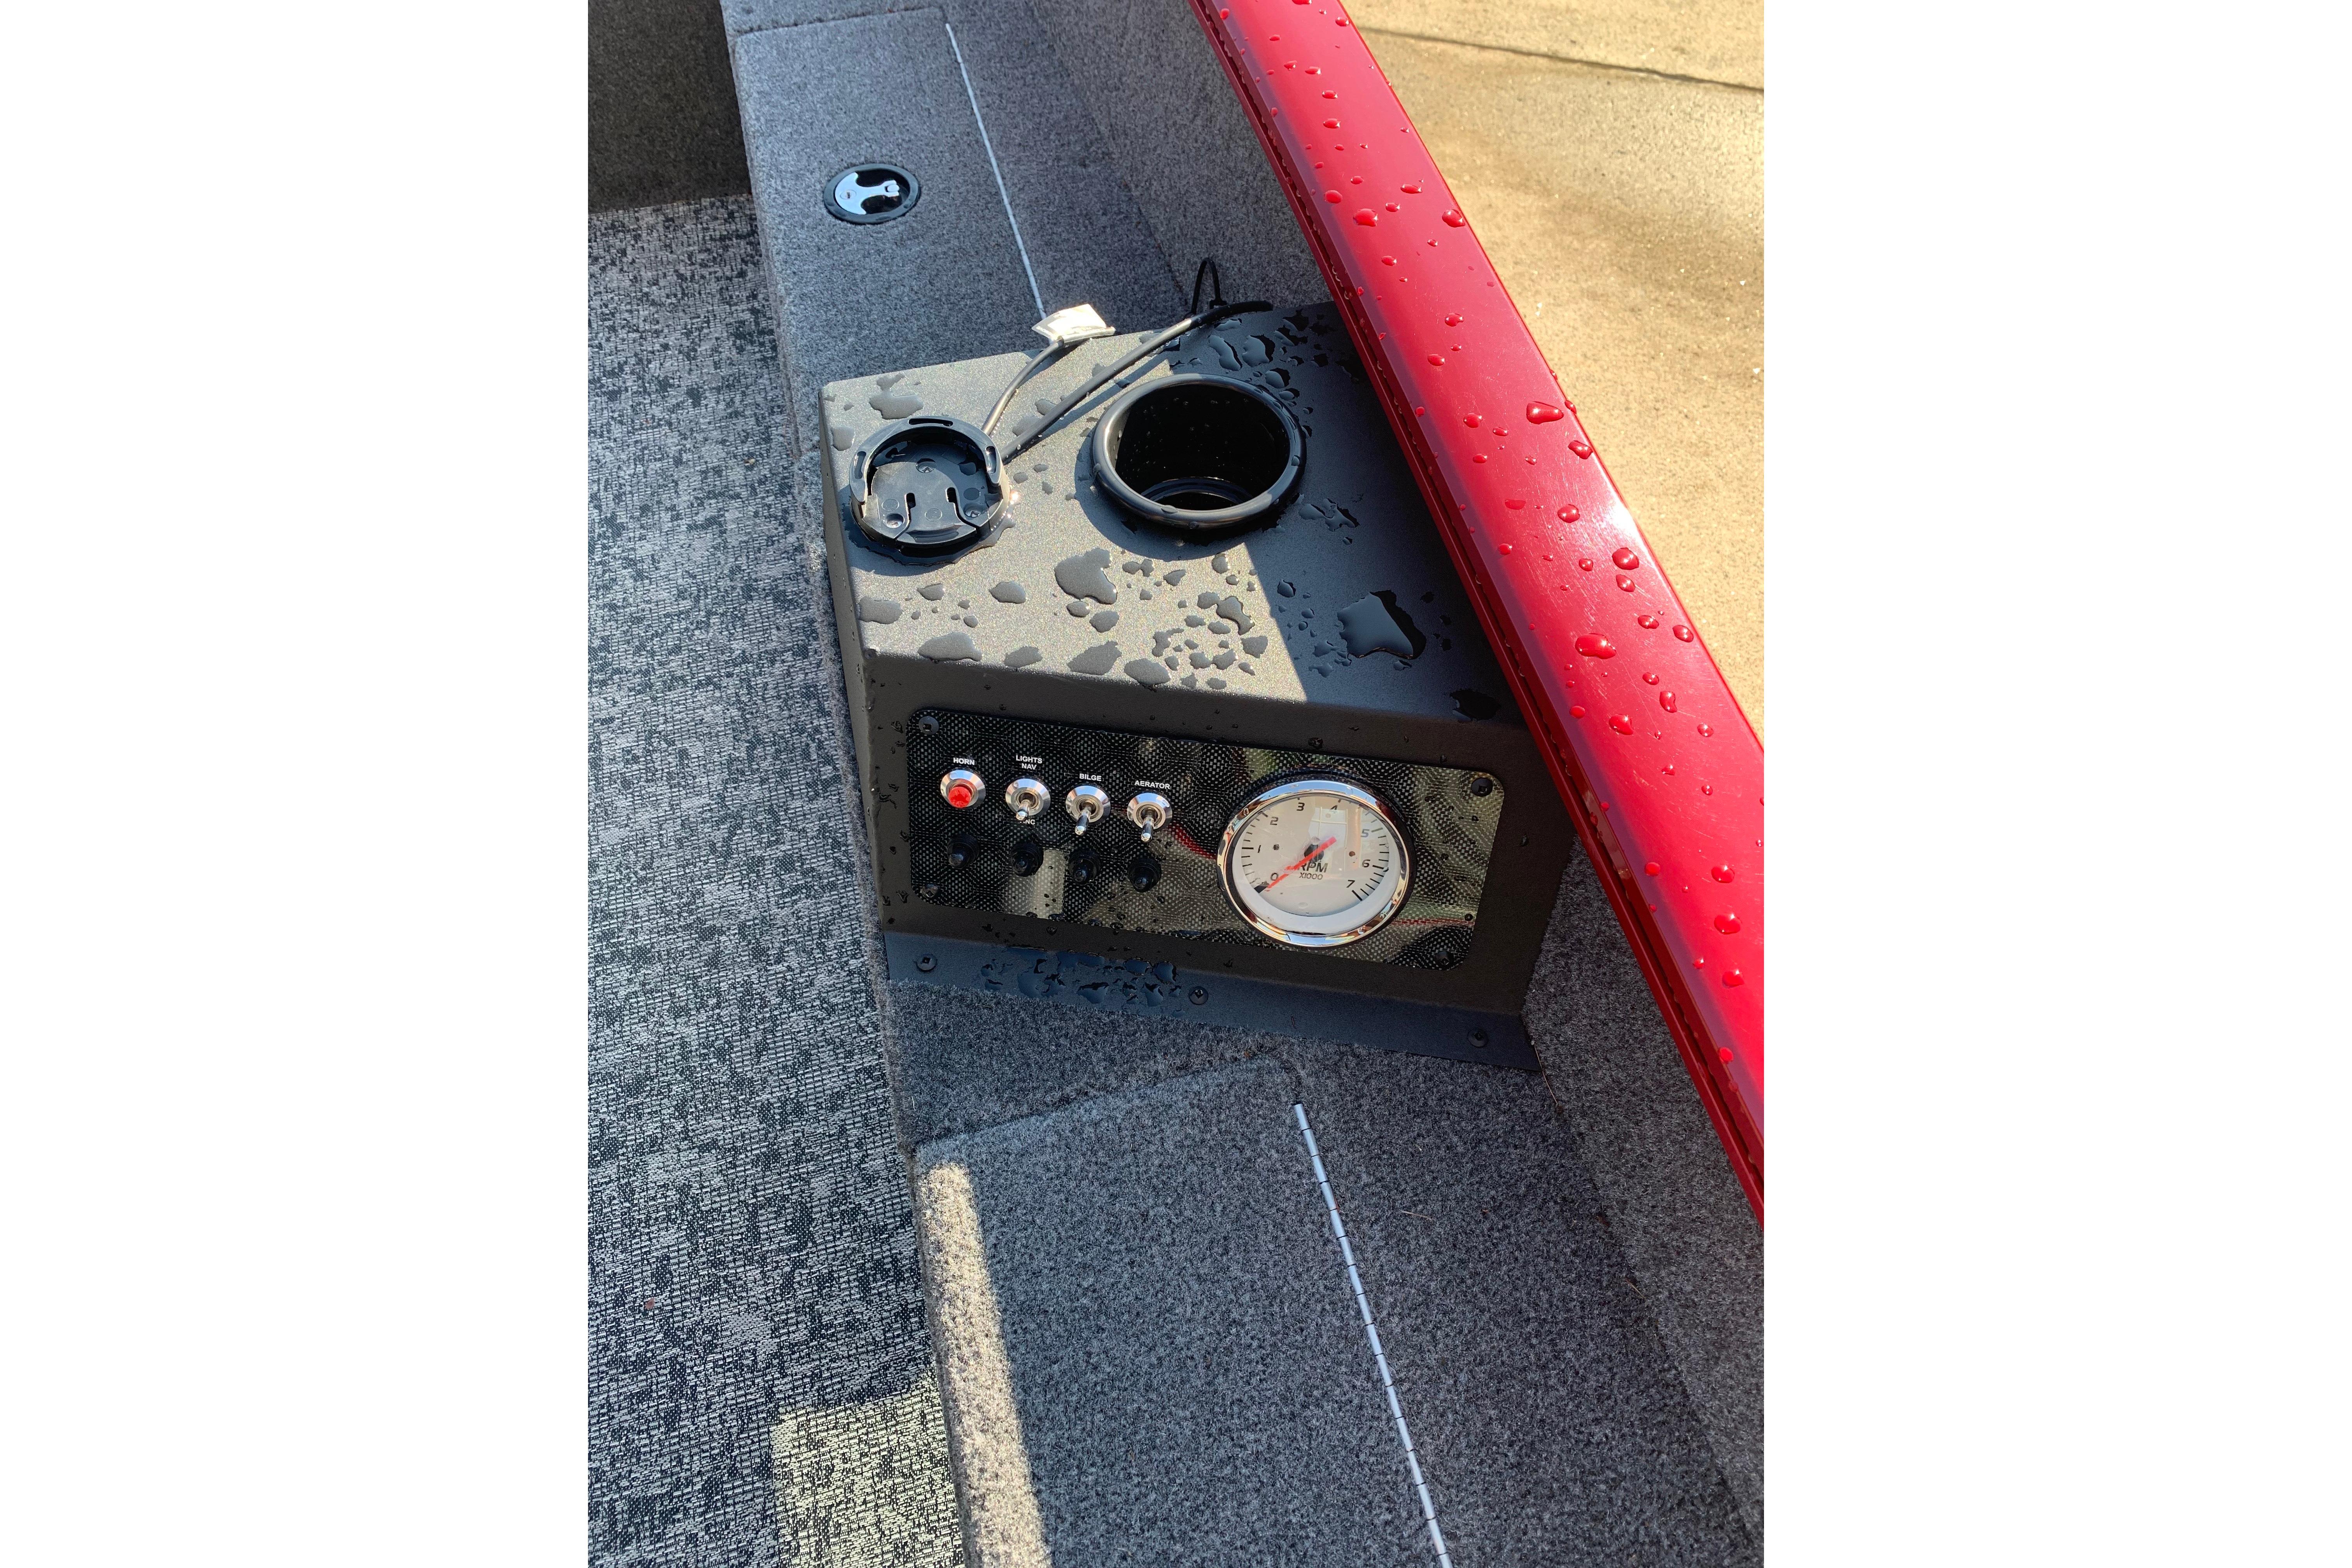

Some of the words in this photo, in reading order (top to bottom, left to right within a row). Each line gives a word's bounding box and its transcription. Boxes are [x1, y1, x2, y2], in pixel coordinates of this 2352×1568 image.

[1016, 755, 1043, 764] LIGHTS
[1079, 773, 1102, 781] BILGE
[1134, 780, 1171, 789] AERATOR
[1296, 802, 1305, 811] 3
[1270, 816, 1279, 826] 2
[1360, 829, 1370, 838] 5
[1362, 859, 1370, 868] 6
[1270, 872, 1279, 881] 0
[1346, 879, 1355, 888] 7
